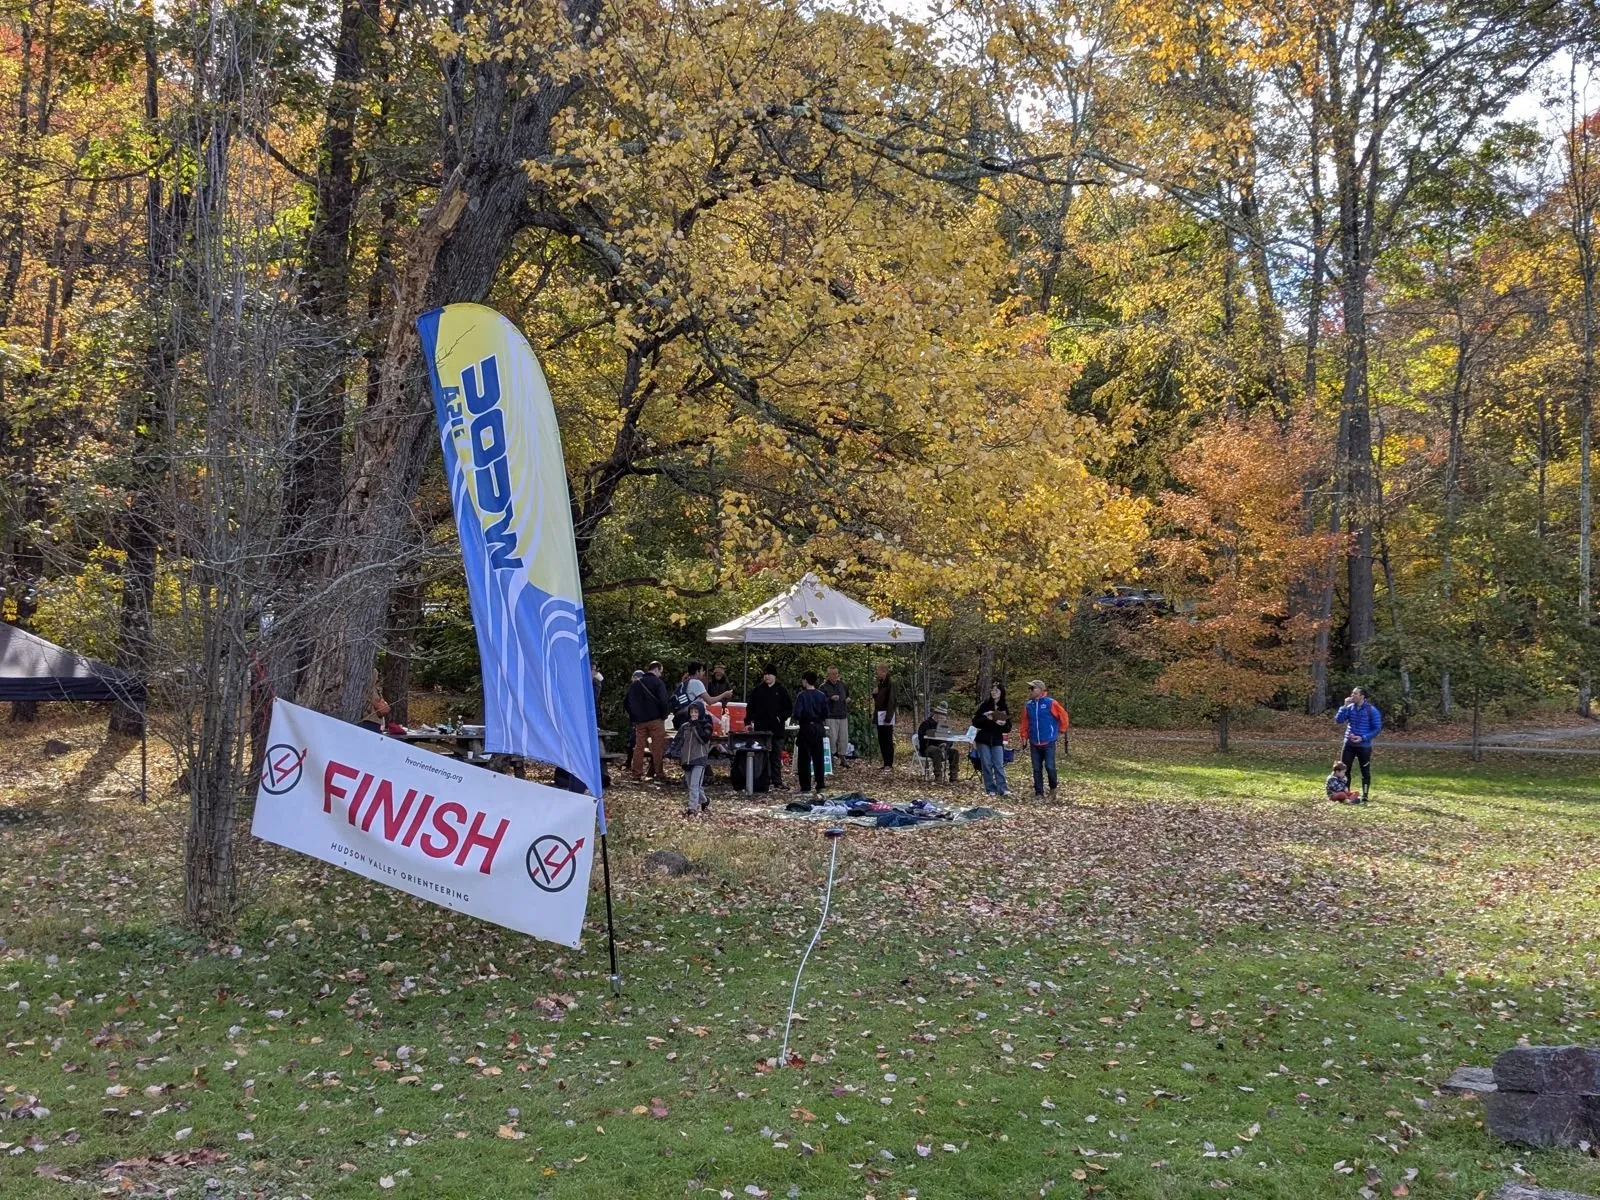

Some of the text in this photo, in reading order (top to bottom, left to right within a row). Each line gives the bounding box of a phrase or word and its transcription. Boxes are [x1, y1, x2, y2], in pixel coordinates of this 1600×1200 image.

[405, 756, 463, 783] hvorienteering.org
[323, 760, 510, 874] FINISH
[331, 842, 470, 902] HUDSON VALLEY ORIENTEERING
